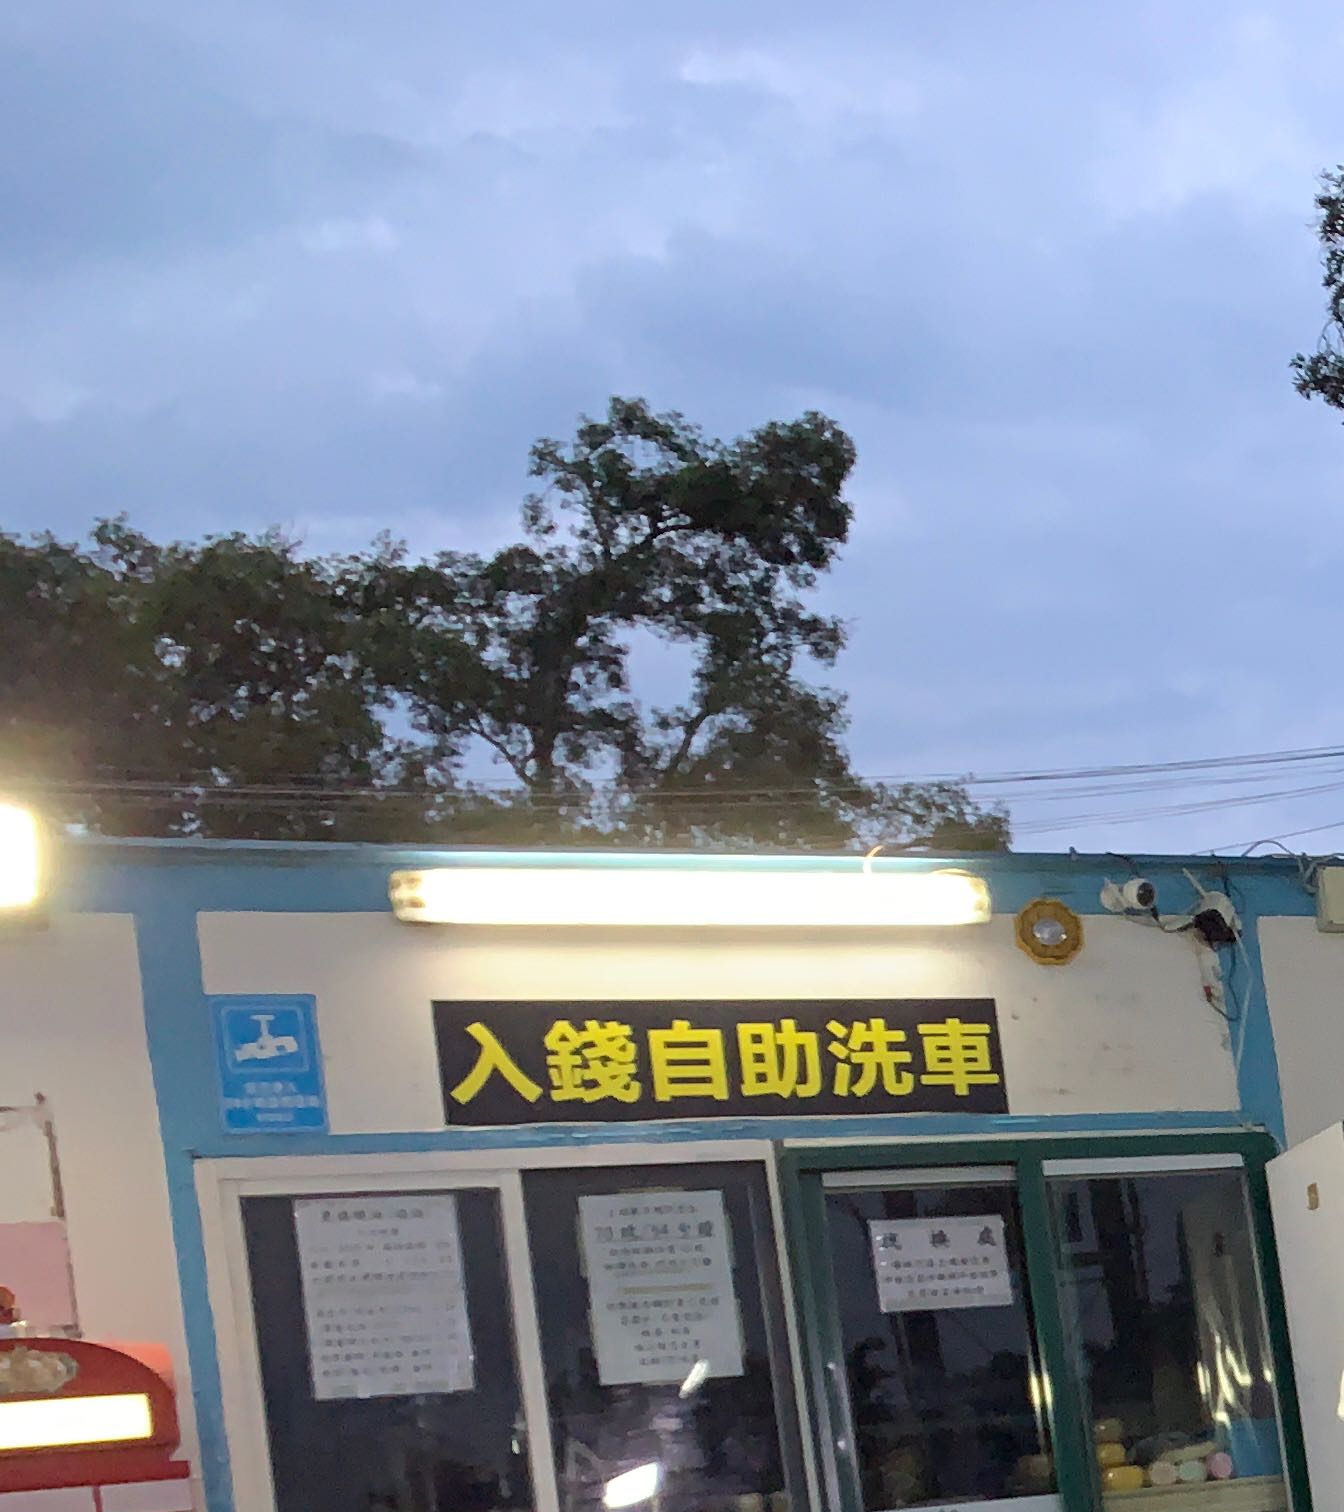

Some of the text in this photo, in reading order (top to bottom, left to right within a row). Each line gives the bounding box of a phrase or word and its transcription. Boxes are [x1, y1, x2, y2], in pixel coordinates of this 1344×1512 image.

[450, 1018, 1000, 1104] 入錢自助洗車
